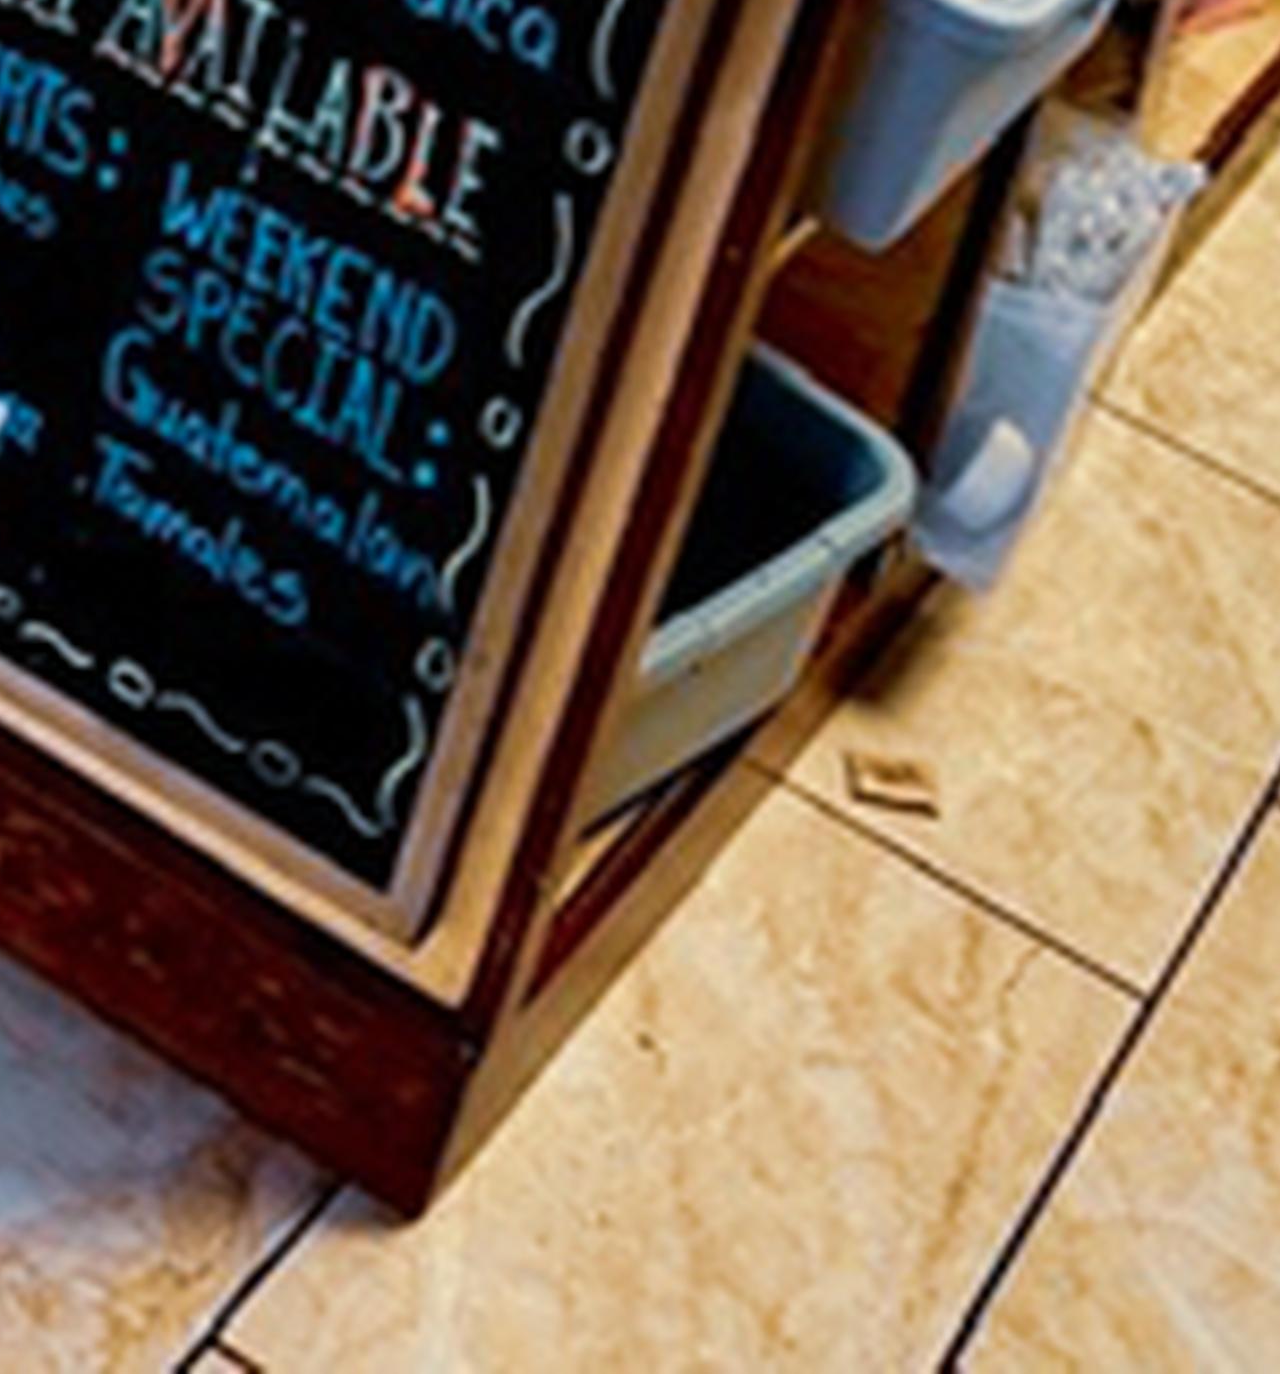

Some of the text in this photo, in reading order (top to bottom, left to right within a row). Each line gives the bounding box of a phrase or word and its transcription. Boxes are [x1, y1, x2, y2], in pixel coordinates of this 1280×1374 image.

[136, 248, 451, 488] SPECIAL:
[160, 160, 458, 384] WEEKEND
[93, 433, 309, 626] Tamales
[101, 326, 445, 610] Guatemalan
